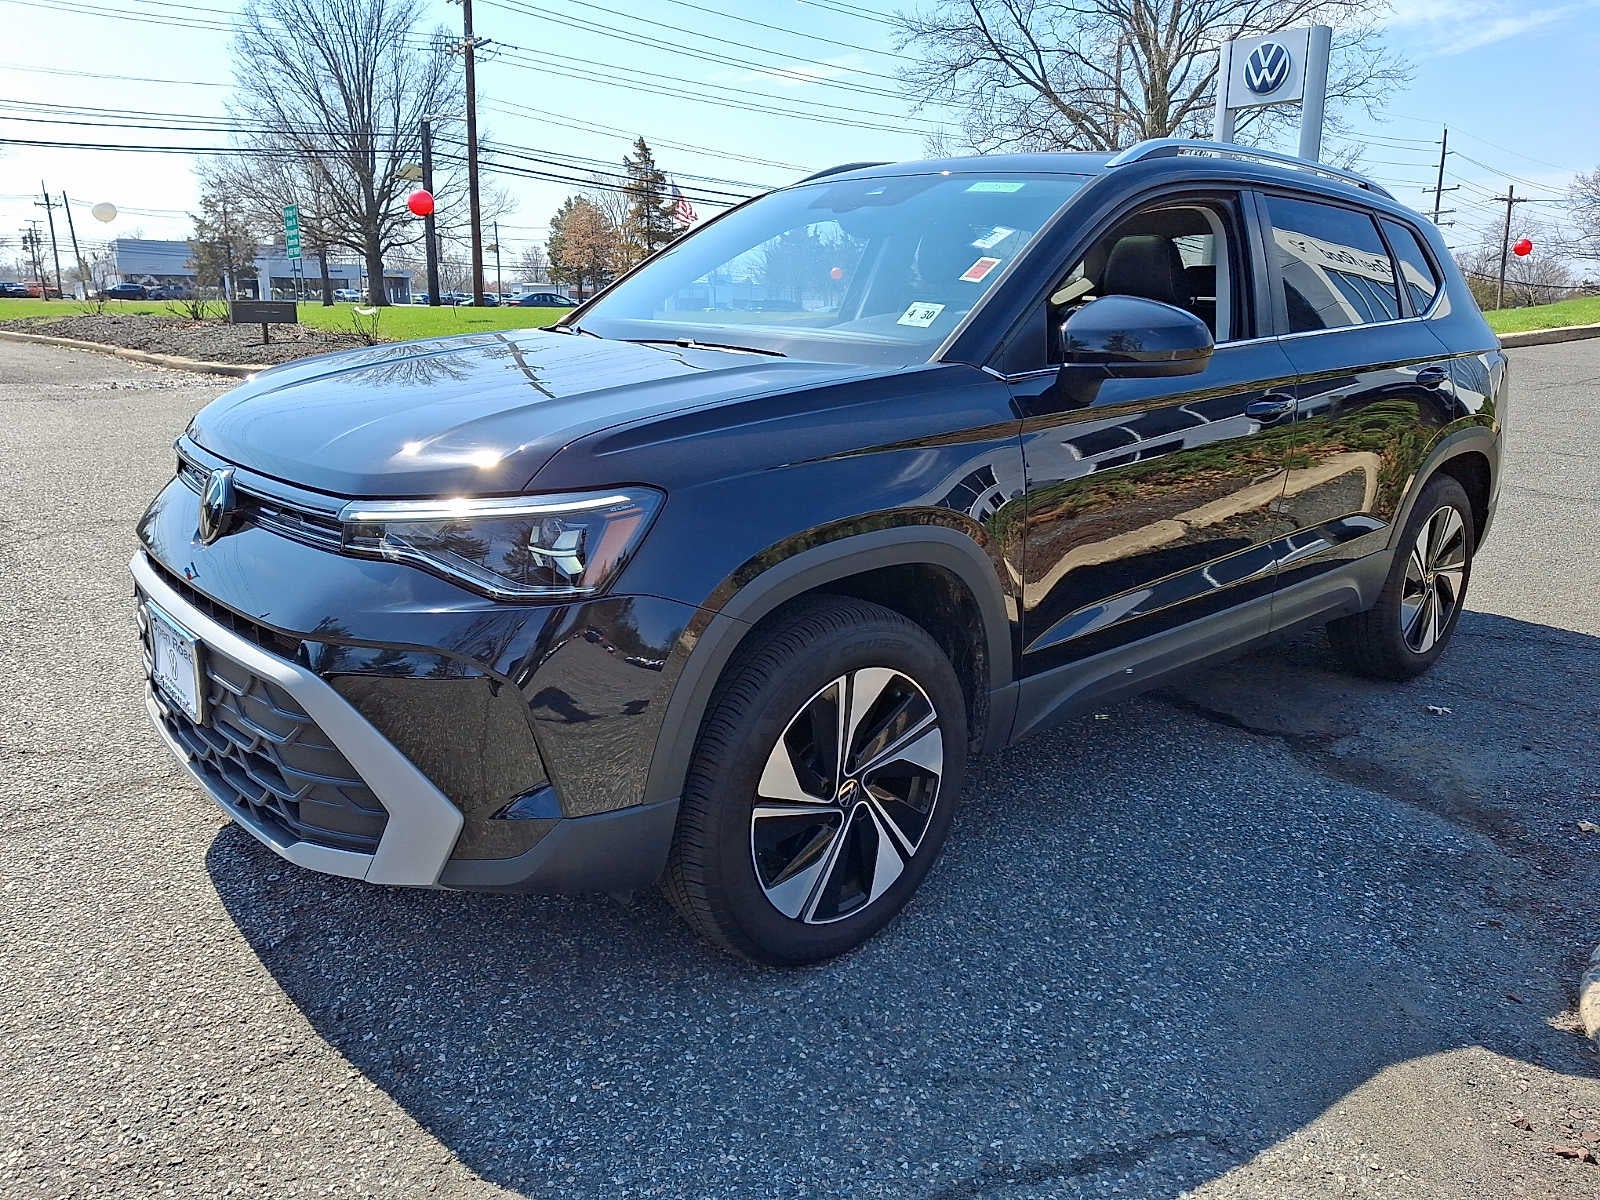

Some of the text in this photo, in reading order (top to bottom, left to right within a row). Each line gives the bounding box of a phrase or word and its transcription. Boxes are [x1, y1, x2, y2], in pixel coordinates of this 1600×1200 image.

[1244, 42, 1289, 94] VW
[908, 309, 935, 319] 4 30
